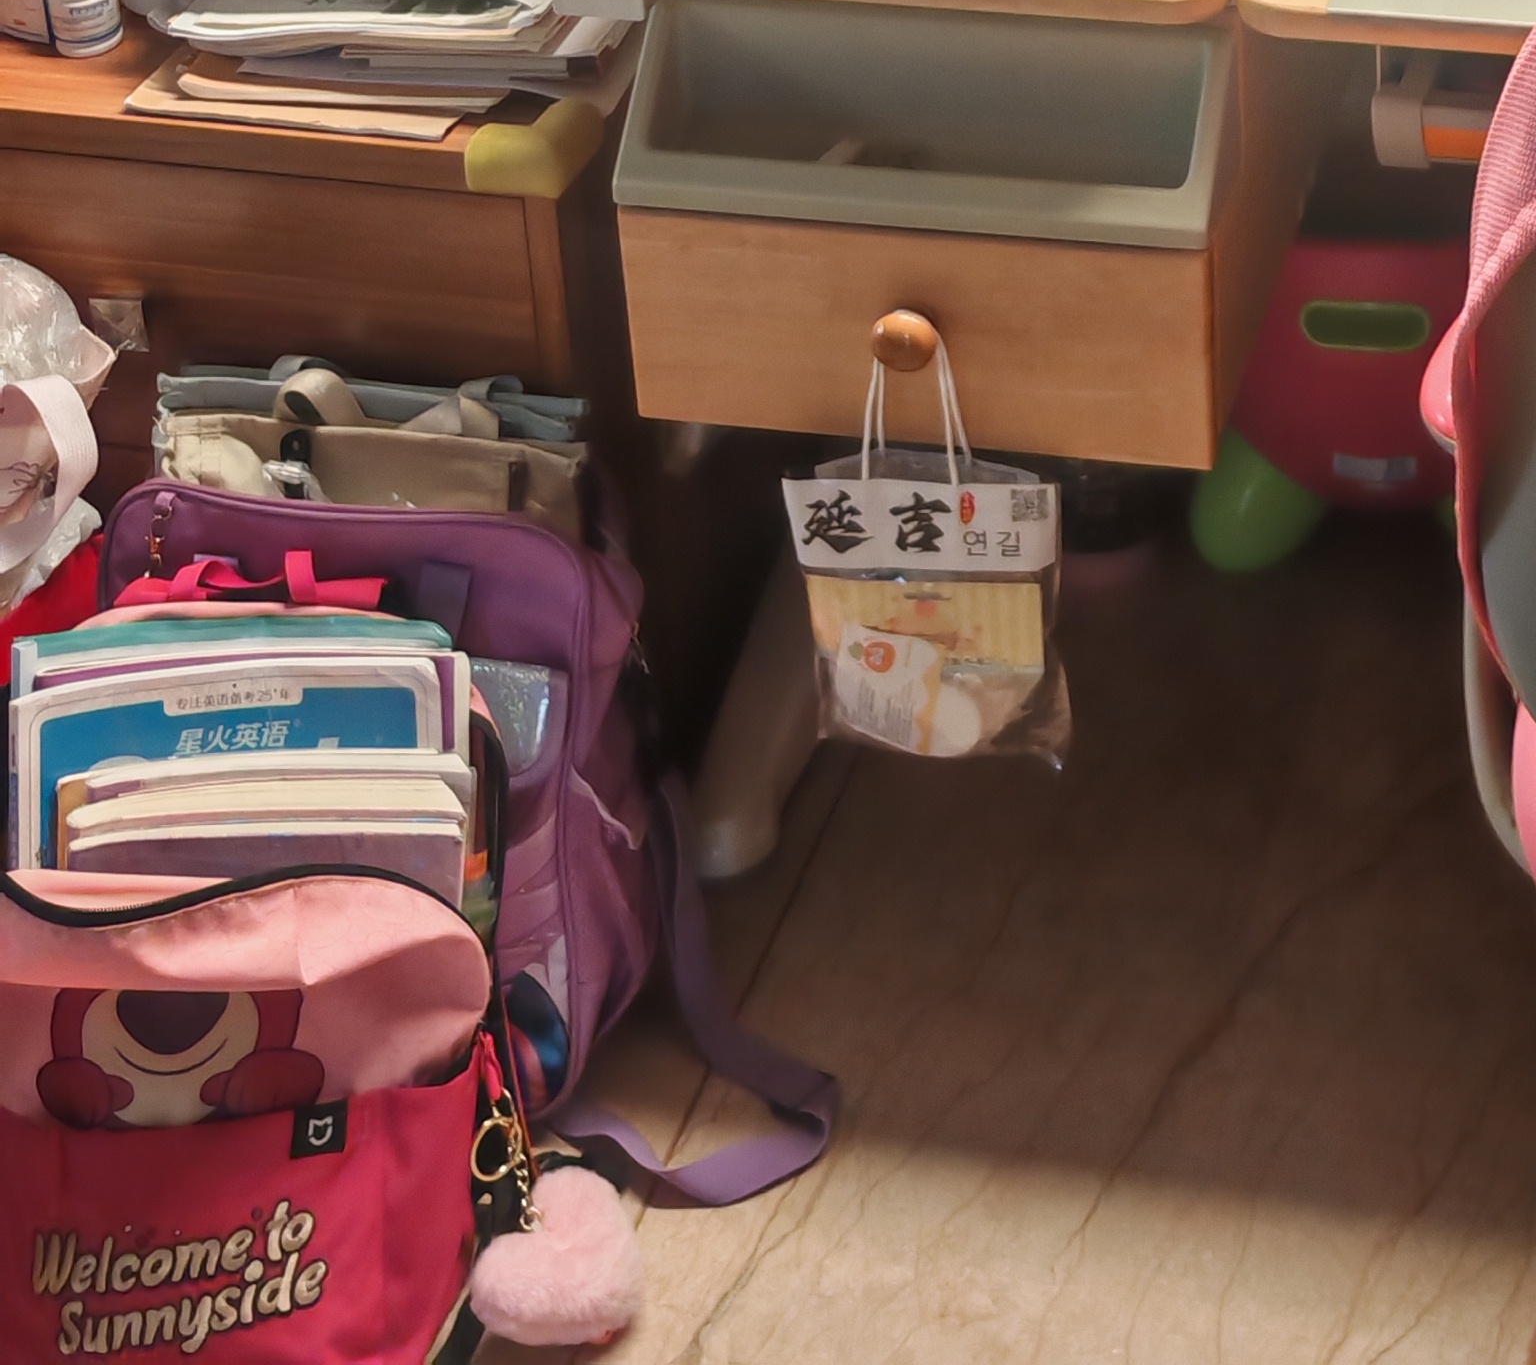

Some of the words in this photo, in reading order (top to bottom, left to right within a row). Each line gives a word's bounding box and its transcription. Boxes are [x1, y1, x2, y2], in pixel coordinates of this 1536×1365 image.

[802, 490, 952, 553] 延吉
[962, 528, 1022, 557] 연길
[174, 720, 291, 758] 星火英语
[33, 1225, 254, 1297] Welcome
[266, 1200, 316, 1264] to
[58, 1256, 328, 1355] Sunnyside
